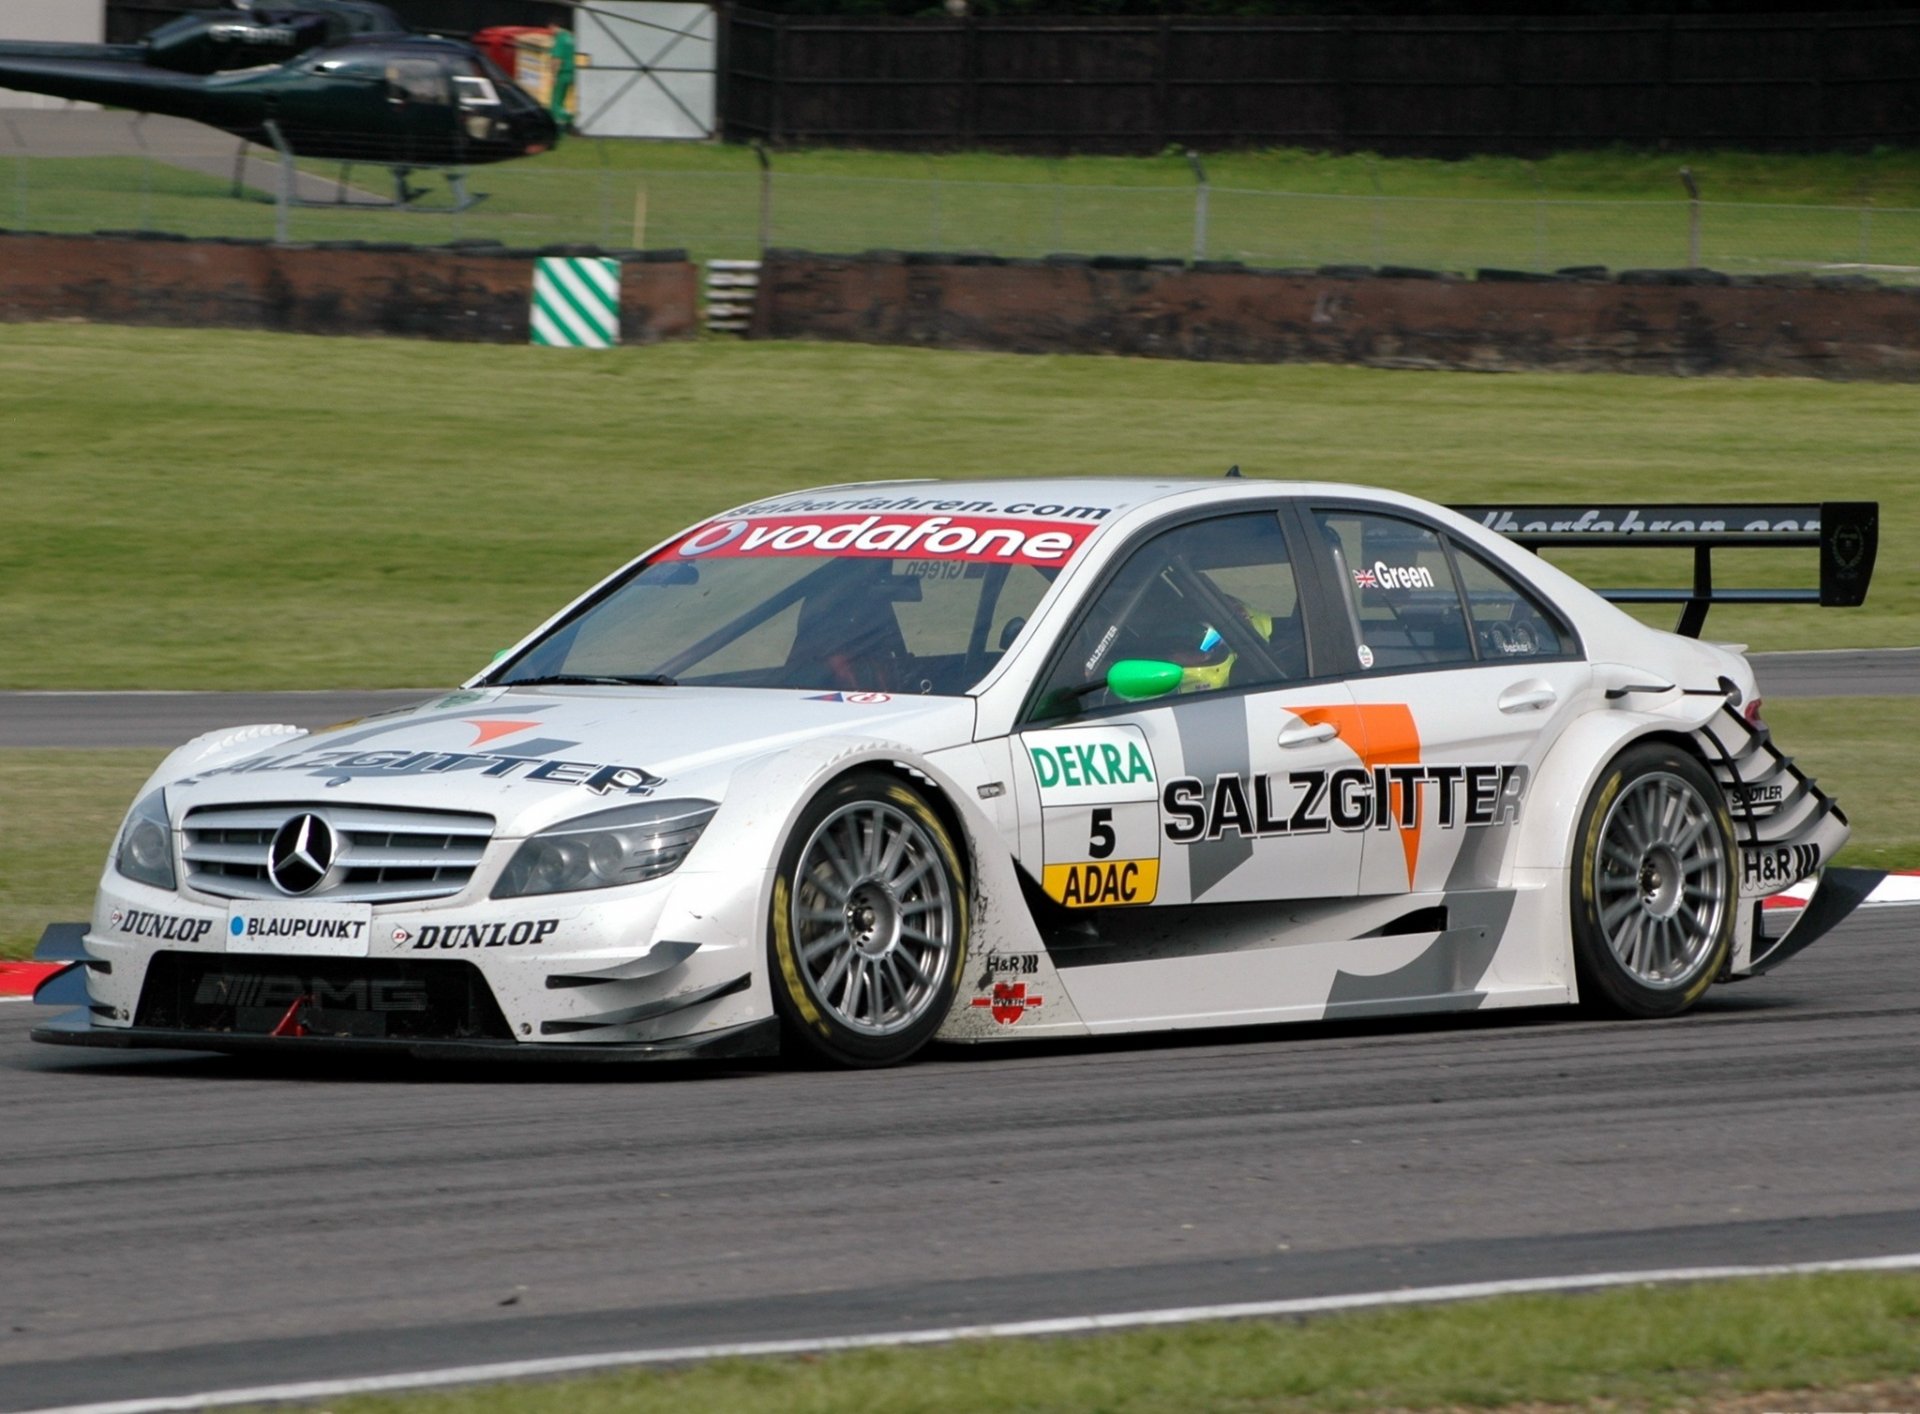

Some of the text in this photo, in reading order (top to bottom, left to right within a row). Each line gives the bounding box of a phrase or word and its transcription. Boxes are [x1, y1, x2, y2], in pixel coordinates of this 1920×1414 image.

[740, 515, 1074, 559] vodafone
[1374, 561, 1434, 589] Green
[1030, 740, 1154, 790] DEKRA
[1163, 763, 1531, 845] SALZGITTER
[1088, 808, 1117, 859] 5
[1062, 862, 1139, 905] ADAC
[120, 909, 213, 943] DUNLOP
[246, 916, 367, 941] BLAUPUNKT
[412, 919, 560, 949] DUNLOP
